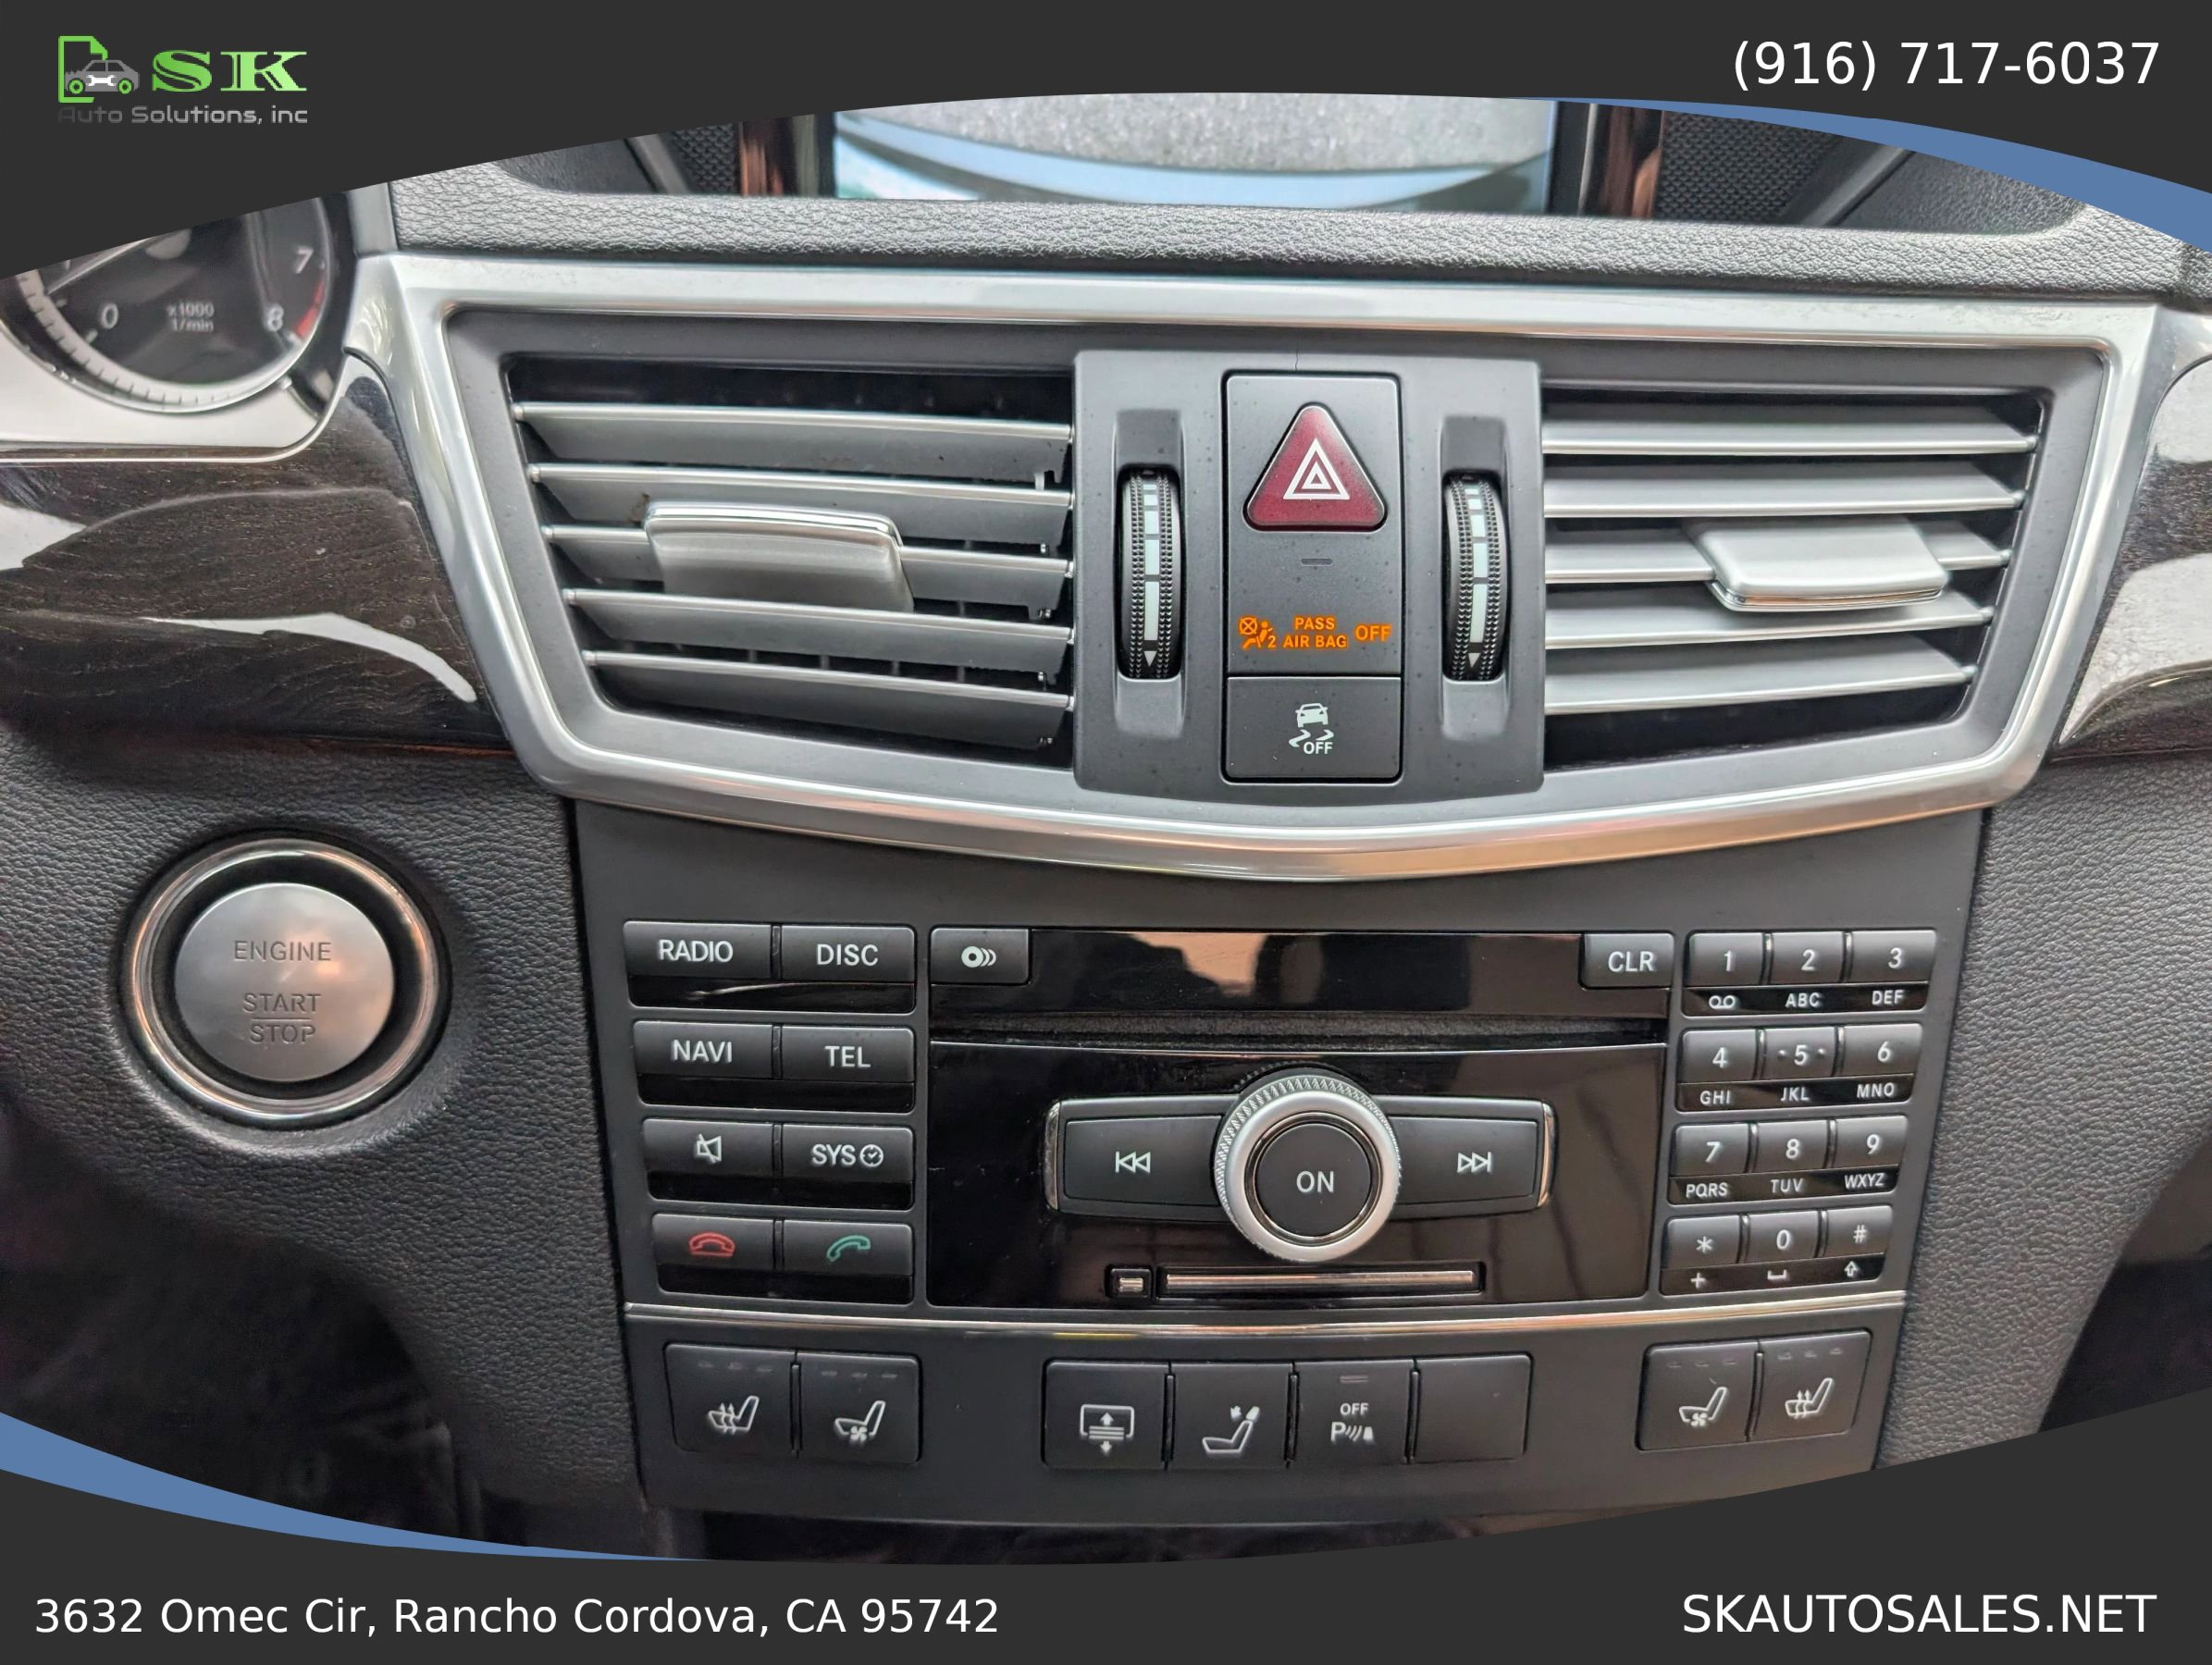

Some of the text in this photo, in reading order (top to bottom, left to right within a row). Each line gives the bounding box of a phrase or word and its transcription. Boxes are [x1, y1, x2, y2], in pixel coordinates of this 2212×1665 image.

[295, 247, 314, 274] 7
[100, 302, 119, 329] 0
[266, 305, 284, 332] 8
[1294, 616, 1335, 631] PASS
[1354, 624, 1392, 642] OFF
[1282, 635, 1347, 648] AIR BAG
[1303, 741, 1333, 755] OFF
[233, 940, 332, 962] ENGINE
[658, 939, 734, 963] RADIO
[817, 944, 879, 967] DISC
[1608, 951, 1655, 972] CLR
[1724, 951, 1733, 971] 1
[1801, 950, 1816, 971] 2
[1888, 947, 1902, 968] 3
[242, 993, 323, 1013] START
[1785, 992, 1821, 1008] ABC
[1872, 989, 1904, 1005] DEF
[249, 1024, 316, 1043] STOP
[672, 1039, 733, 1063] NAVI
[824, 1045, 871, 1067] TEL
[1712, 1046, 1727, 1068] 4
[1794, 1044, 1808, 1066] 5
[1877, 1041, 1891, 1062] 6
[1699, 1090, 1731, 1105] GHI
[1780, 1087, 1810, 1102] JKL
[1856, 1081, 1896, 1098] MNO
[1706, 1141, 1722, 1162] 7
[1786, 1138, 1800, 1159] 8
[1866, 1133, 1881, 1154] 9
[811, 1143, 857, 1166] SYS
[1296, 1170, 1334, 1193] ON
[1686, 1181, 1728, 1198] PQRS
[1770, 1178, 1804, 1193] TUV
[1844, 1172, 1885, 1190] WXYZ
[1776, 1228, 1792, 1250] 0
[1340, 1402, 1369, 1416] OFF
